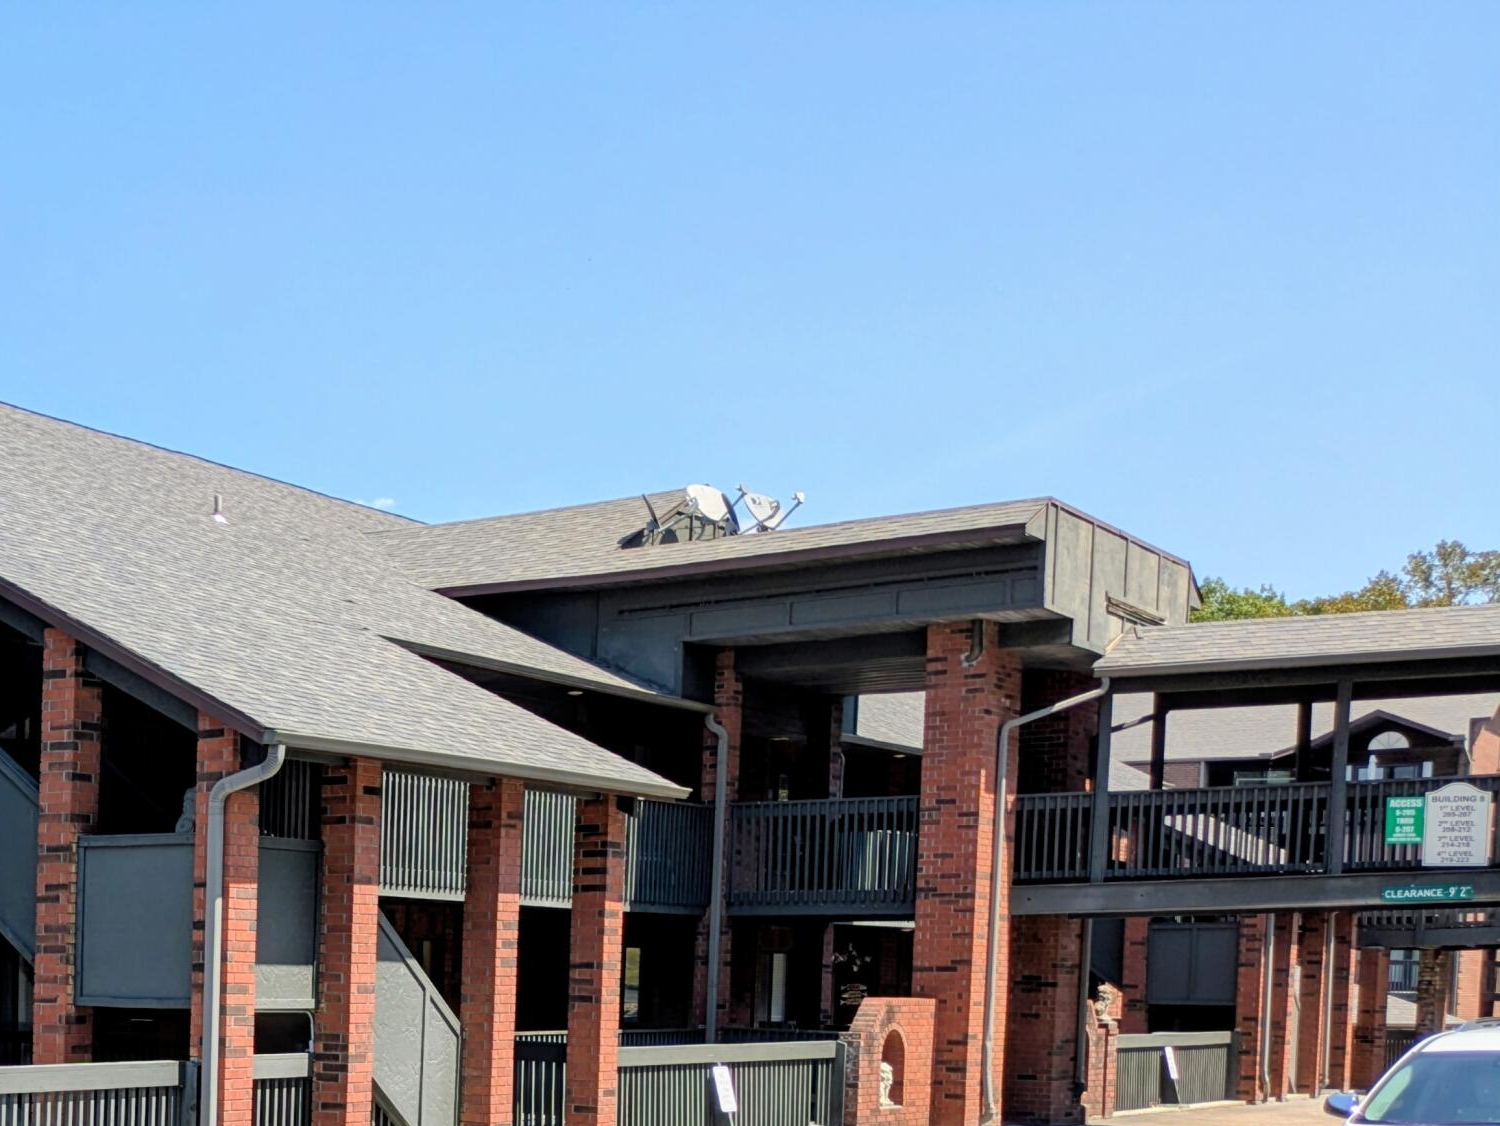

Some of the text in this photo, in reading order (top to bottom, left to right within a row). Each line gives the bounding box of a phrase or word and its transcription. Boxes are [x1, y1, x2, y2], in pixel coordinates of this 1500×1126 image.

[1389, 799, 1422, 808] ACCESS
[1431, 795, 1477, 803] BUILDING
[1384, 888, 1444, 899] CLEARANCE
